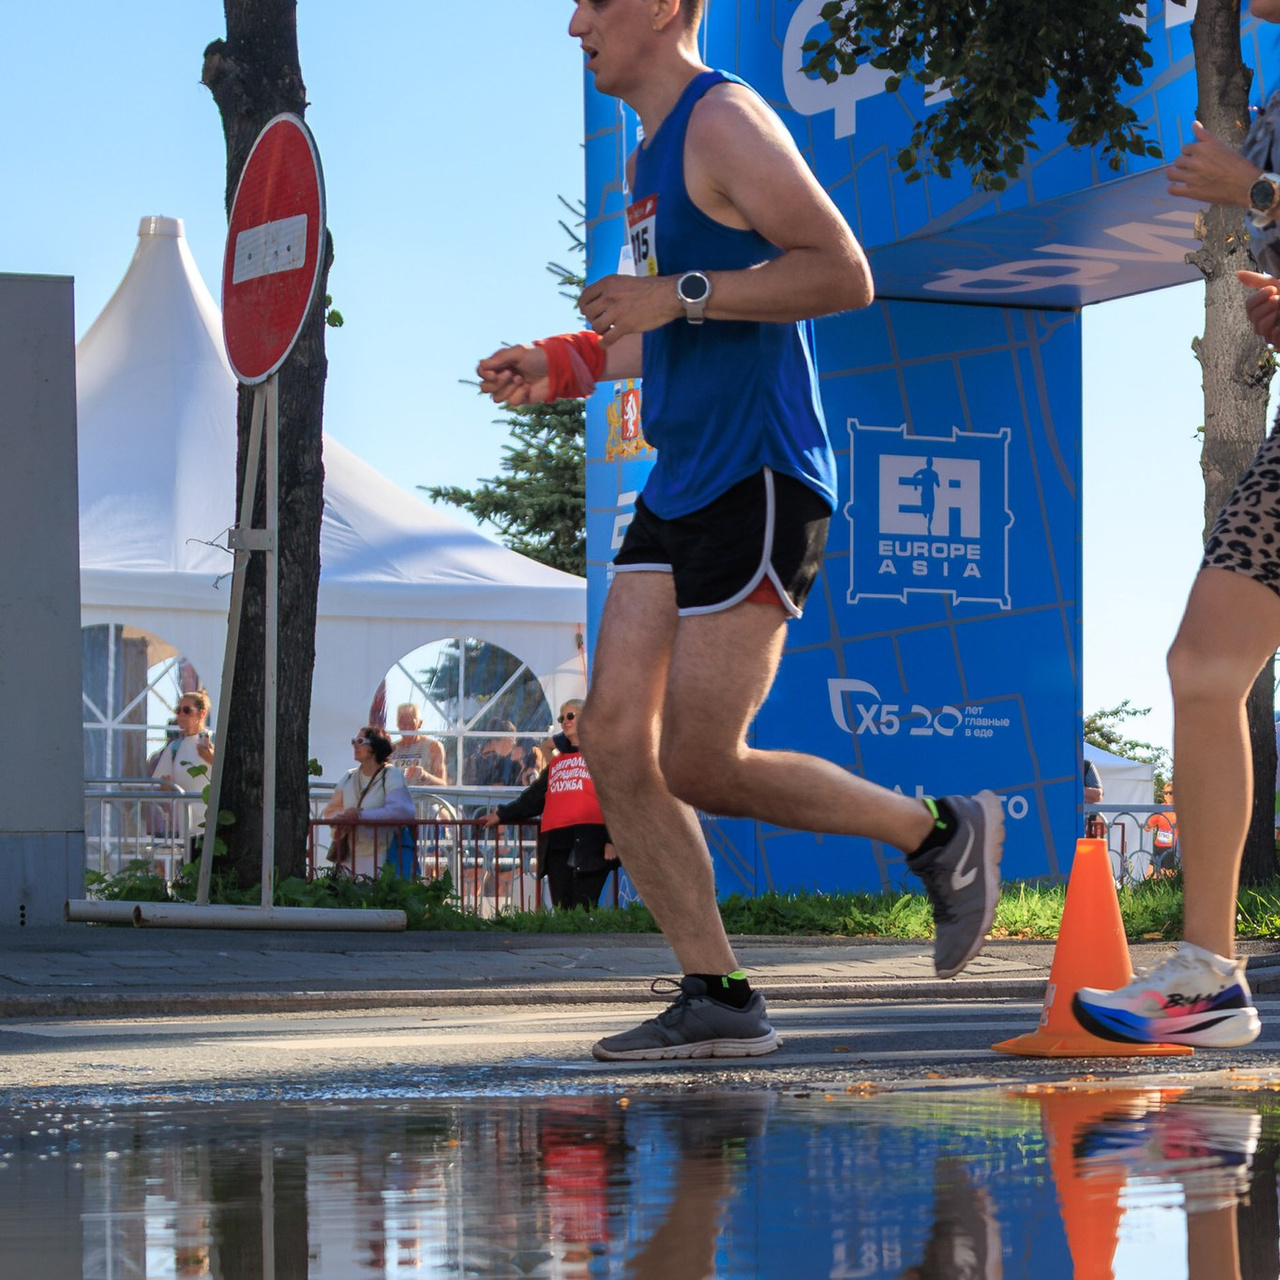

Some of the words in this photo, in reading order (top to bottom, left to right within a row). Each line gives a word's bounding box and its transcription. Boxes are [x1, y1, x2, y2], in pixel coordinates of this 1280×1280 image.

[879, 540, 980, 559] EUROPE
[879, 559, 981, 578] ASIA
[965, 705, 983, 715] лет
[856, 704, 900, 735] X5
[909, 704, 963, 736] 20
[965, 717, 1010, 727] главные
[965, 728, 971, 736] в
[973, 727, 993, 738] еде
